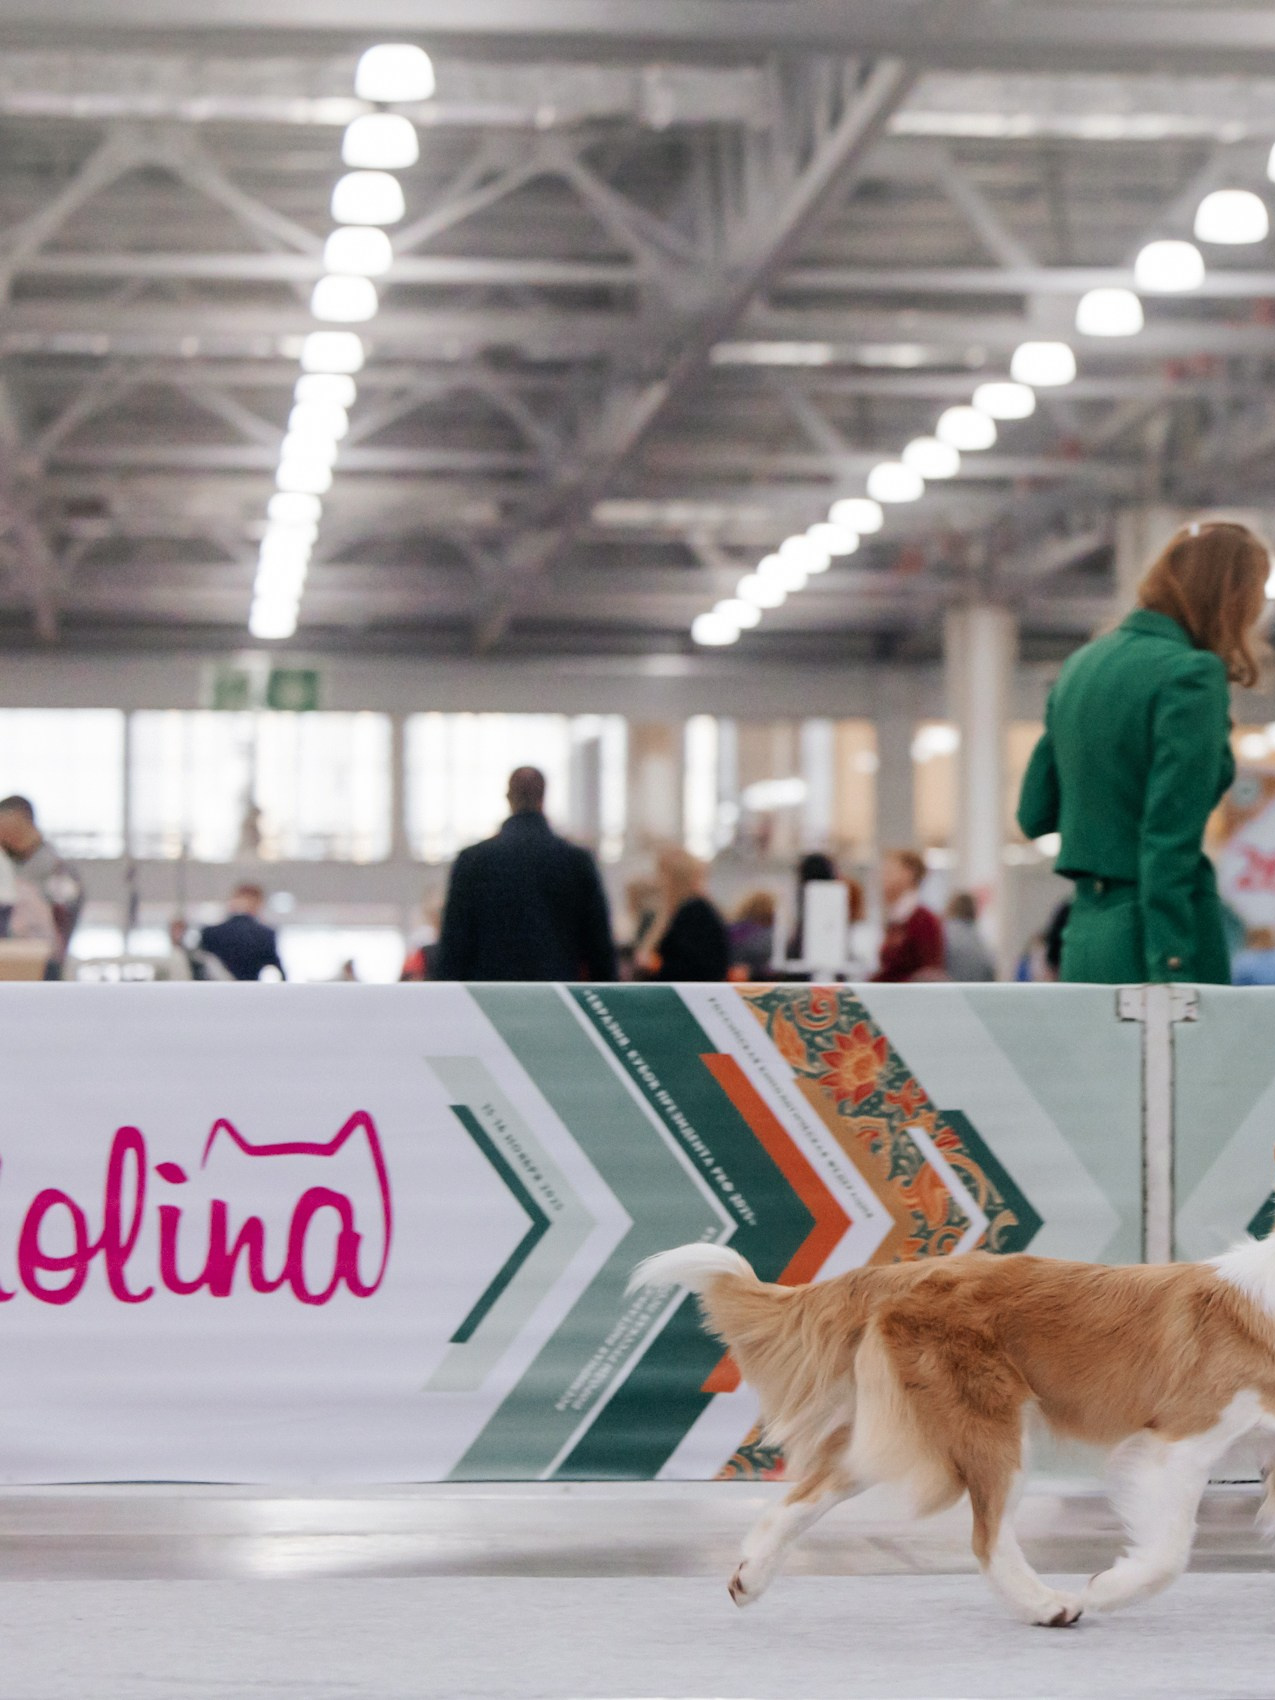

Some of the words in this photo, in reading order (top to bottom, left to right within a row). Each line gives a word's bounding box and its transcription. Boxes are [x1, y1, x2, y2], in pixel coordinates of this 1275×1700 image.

[627, 1048, 661, 1090] КУБОК
[655, 1088, 716, 1168] ПРЕЗИДЕНТА
[0, 1111, 392, 1306] olina
